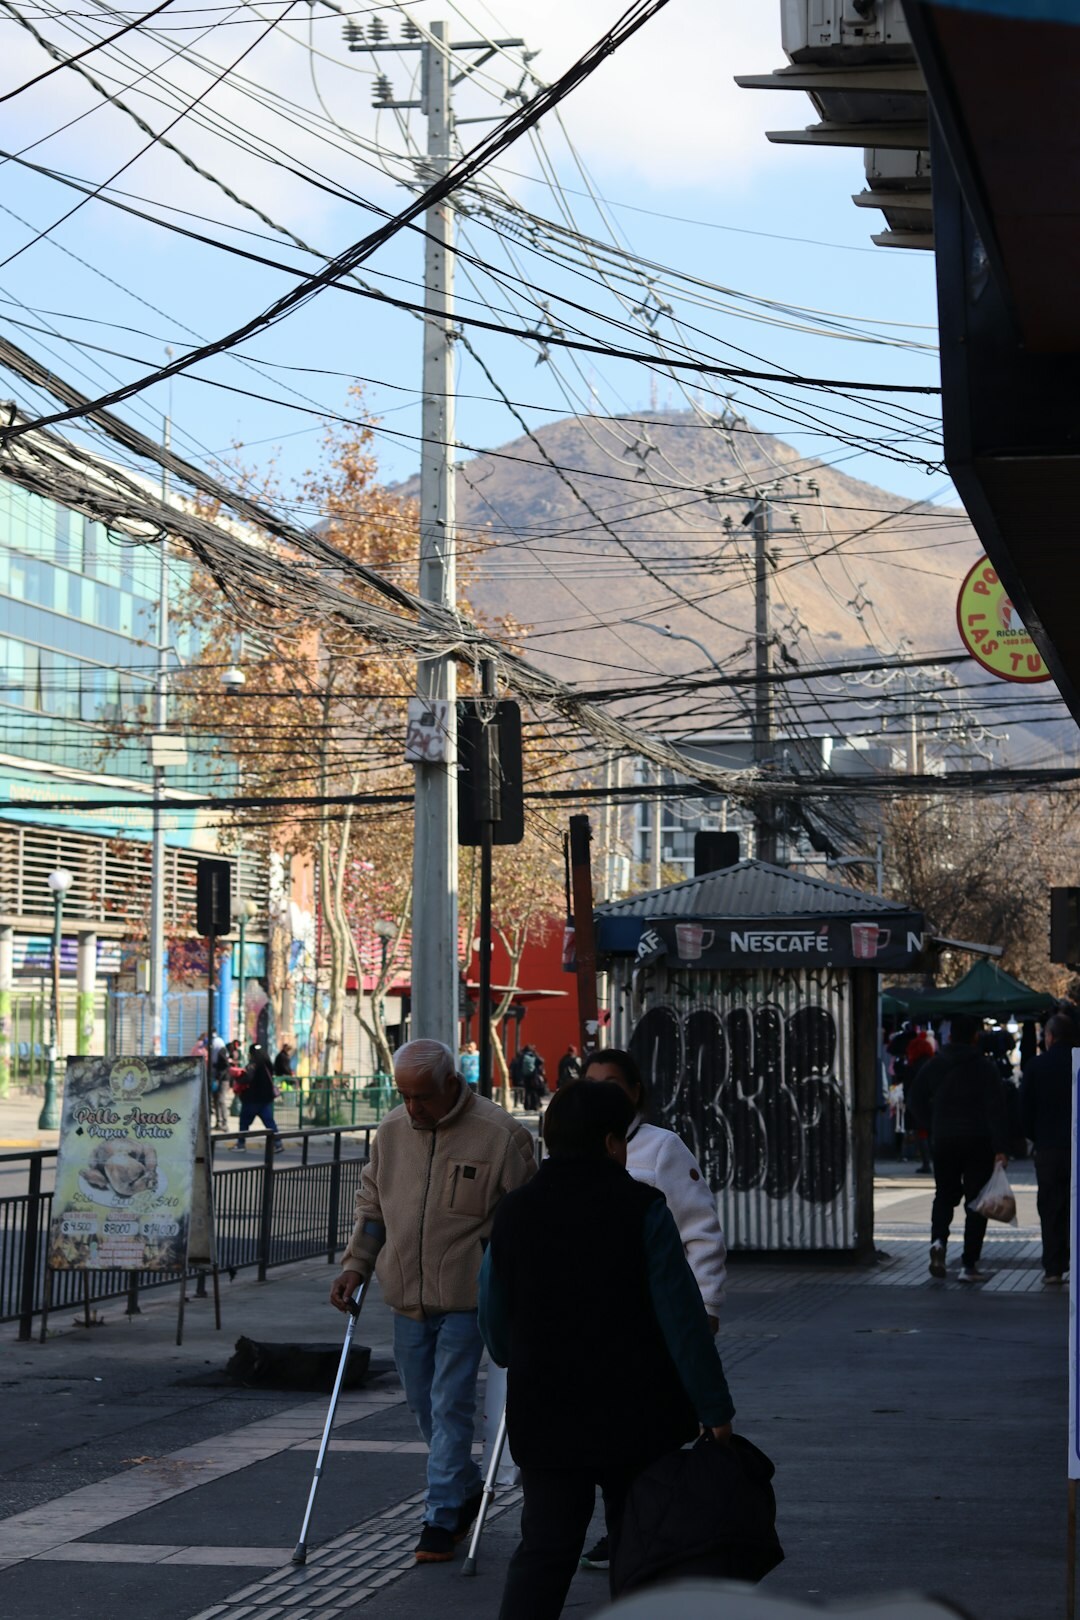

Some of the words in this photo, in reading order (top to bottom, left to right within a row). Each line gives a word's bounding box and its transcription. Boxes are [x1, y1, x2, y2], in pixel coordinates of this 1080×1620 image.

[968, 613, 999, 656] LAS
[996, 629, 1016, 637] RICO
[730, 924, 829, 953] NESCAFÉ
[75, 1107, 120, 1125] Pollo
[123, 1107, 181, 1126] Asado
[87, 1125, 129, 1140] Papas
